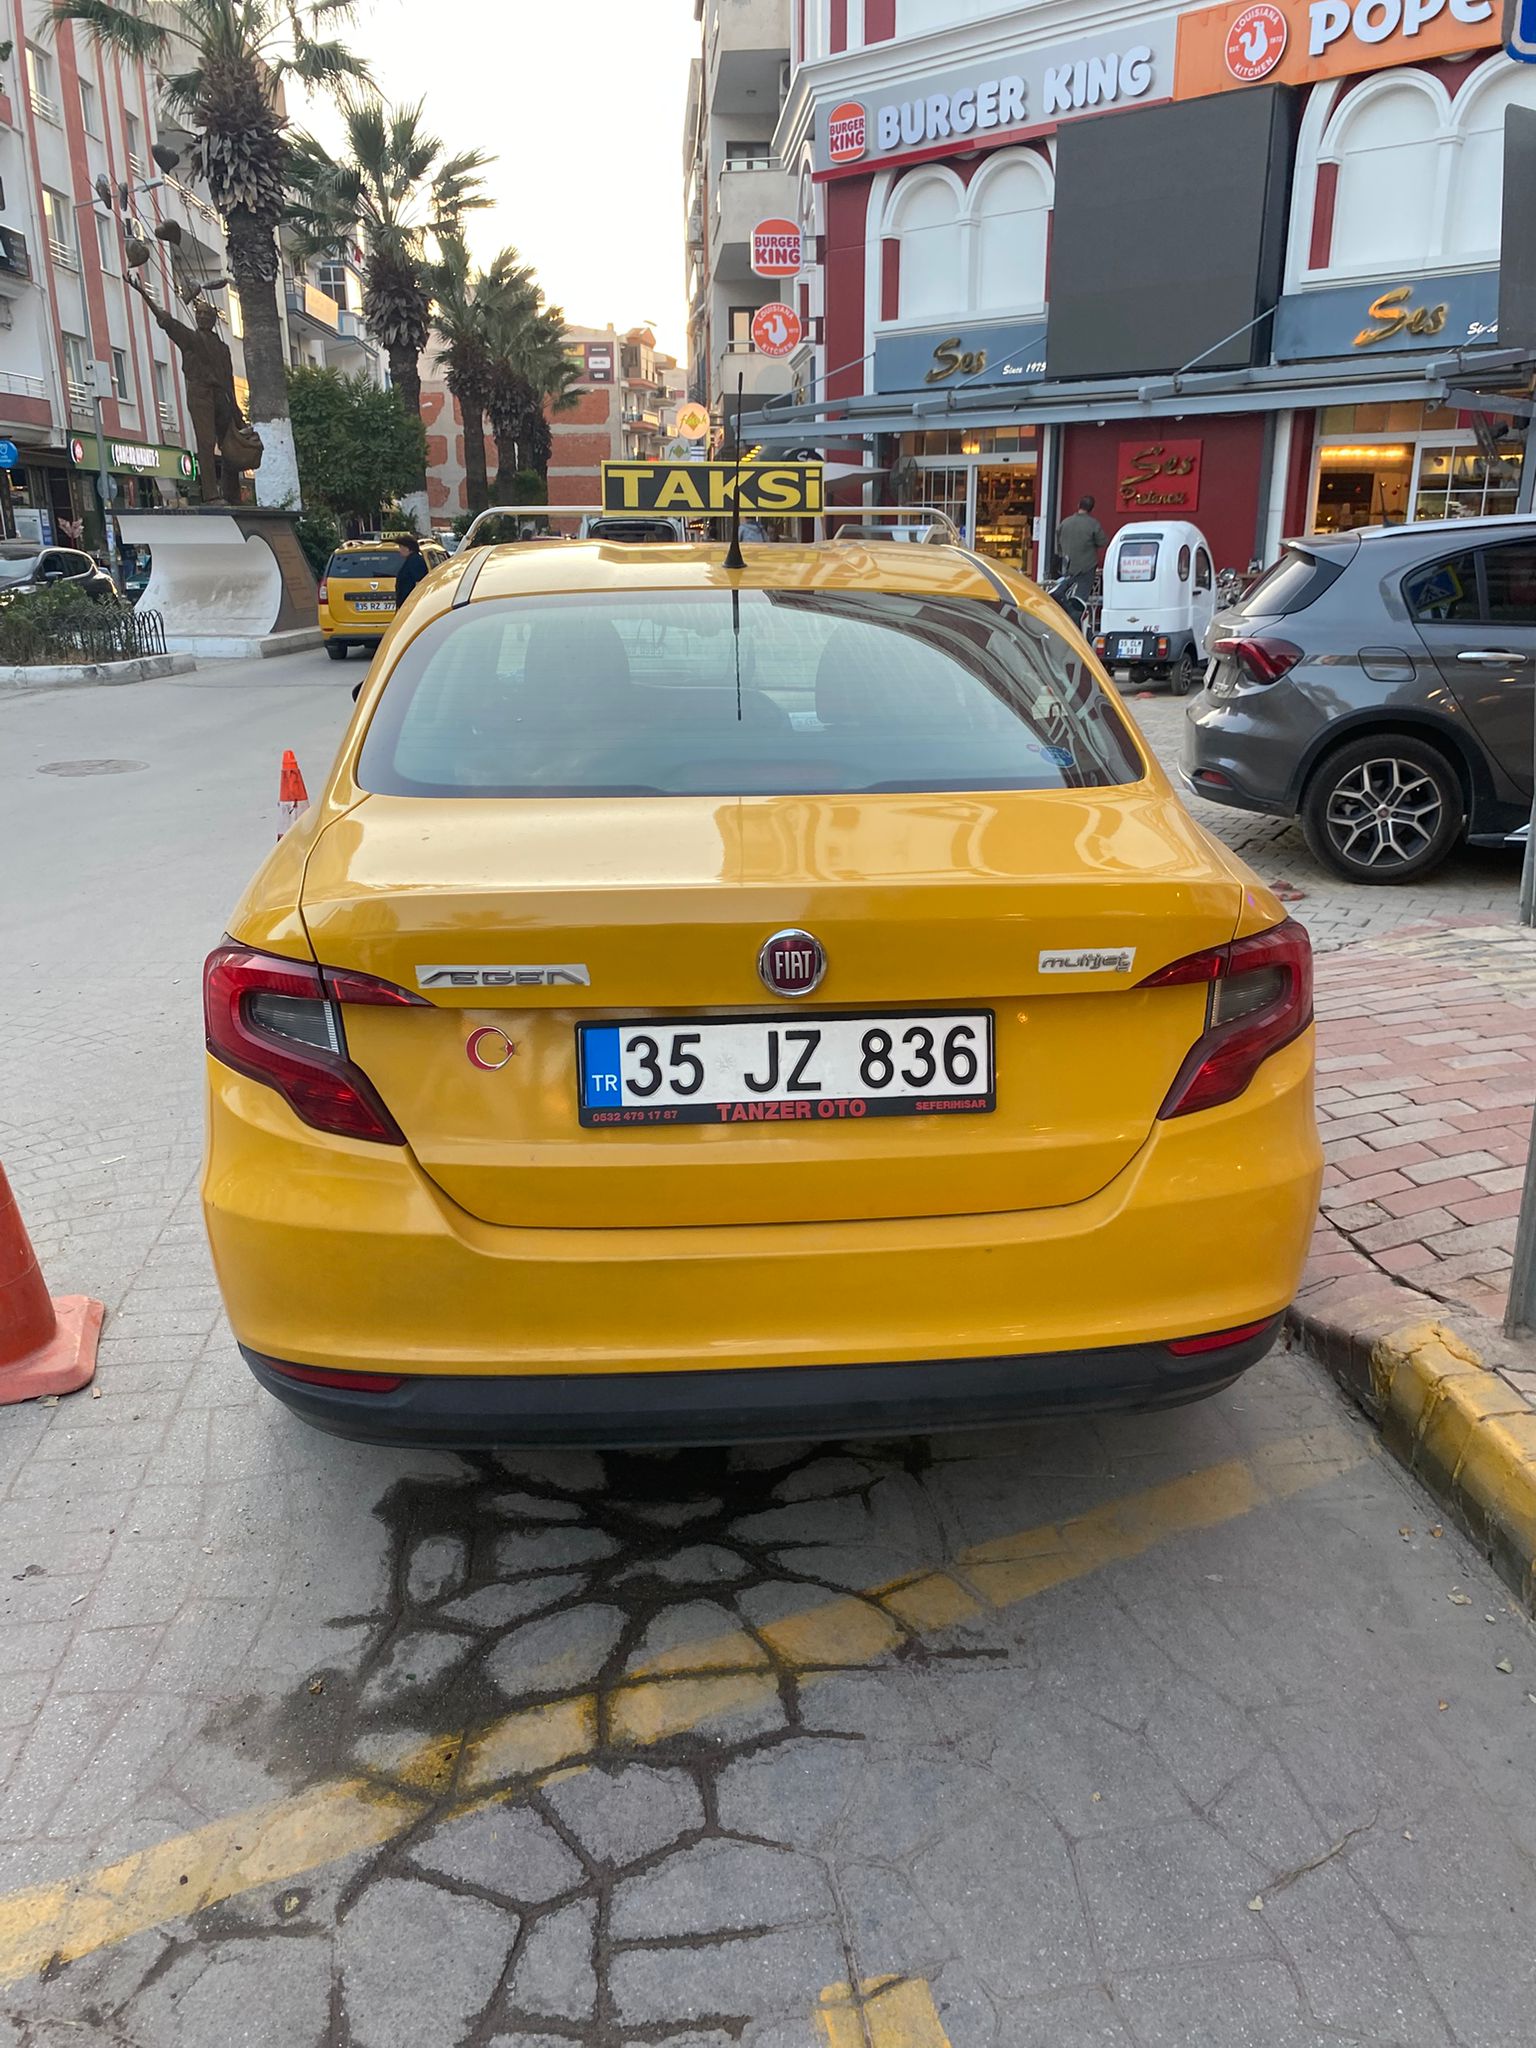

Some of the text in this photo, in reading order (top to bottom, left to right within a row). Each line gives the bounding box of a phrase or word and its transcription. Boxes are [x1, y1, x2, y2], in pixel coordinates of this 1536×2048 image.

[1234, 7, 1280, 33] LOUISIANA
[1234, 56, 1274, 77] KITCHEN
[877, 45, 1152, 150] BURGER KING
[830, 117, 865, 136] BURGER
[830, 130, 865, 153] KING
[755, 236, 801, 248] BURGER
[755, 248, 801, 265] KING
[757, 304, 795, 321] LOUISIANA
[1353, 286, 1447, 346] Ses
[925, 337, 987, 385] Ses
[1121, 447, 1195, 486] Ses
[370, 602, 381, 610] RZ
[775, 950, 812, 979] FIAT
[625, 1025, 978, 1097] 35 JZ 836
[592, 1074, 617, 1092] TR
[592, 1113, 620, 1122] 0532
[648, 1111, 661, 1120] 17
[663, 1110, 678, 1119] 87
[716, 1099, 866, 1122] TANZER OTO
